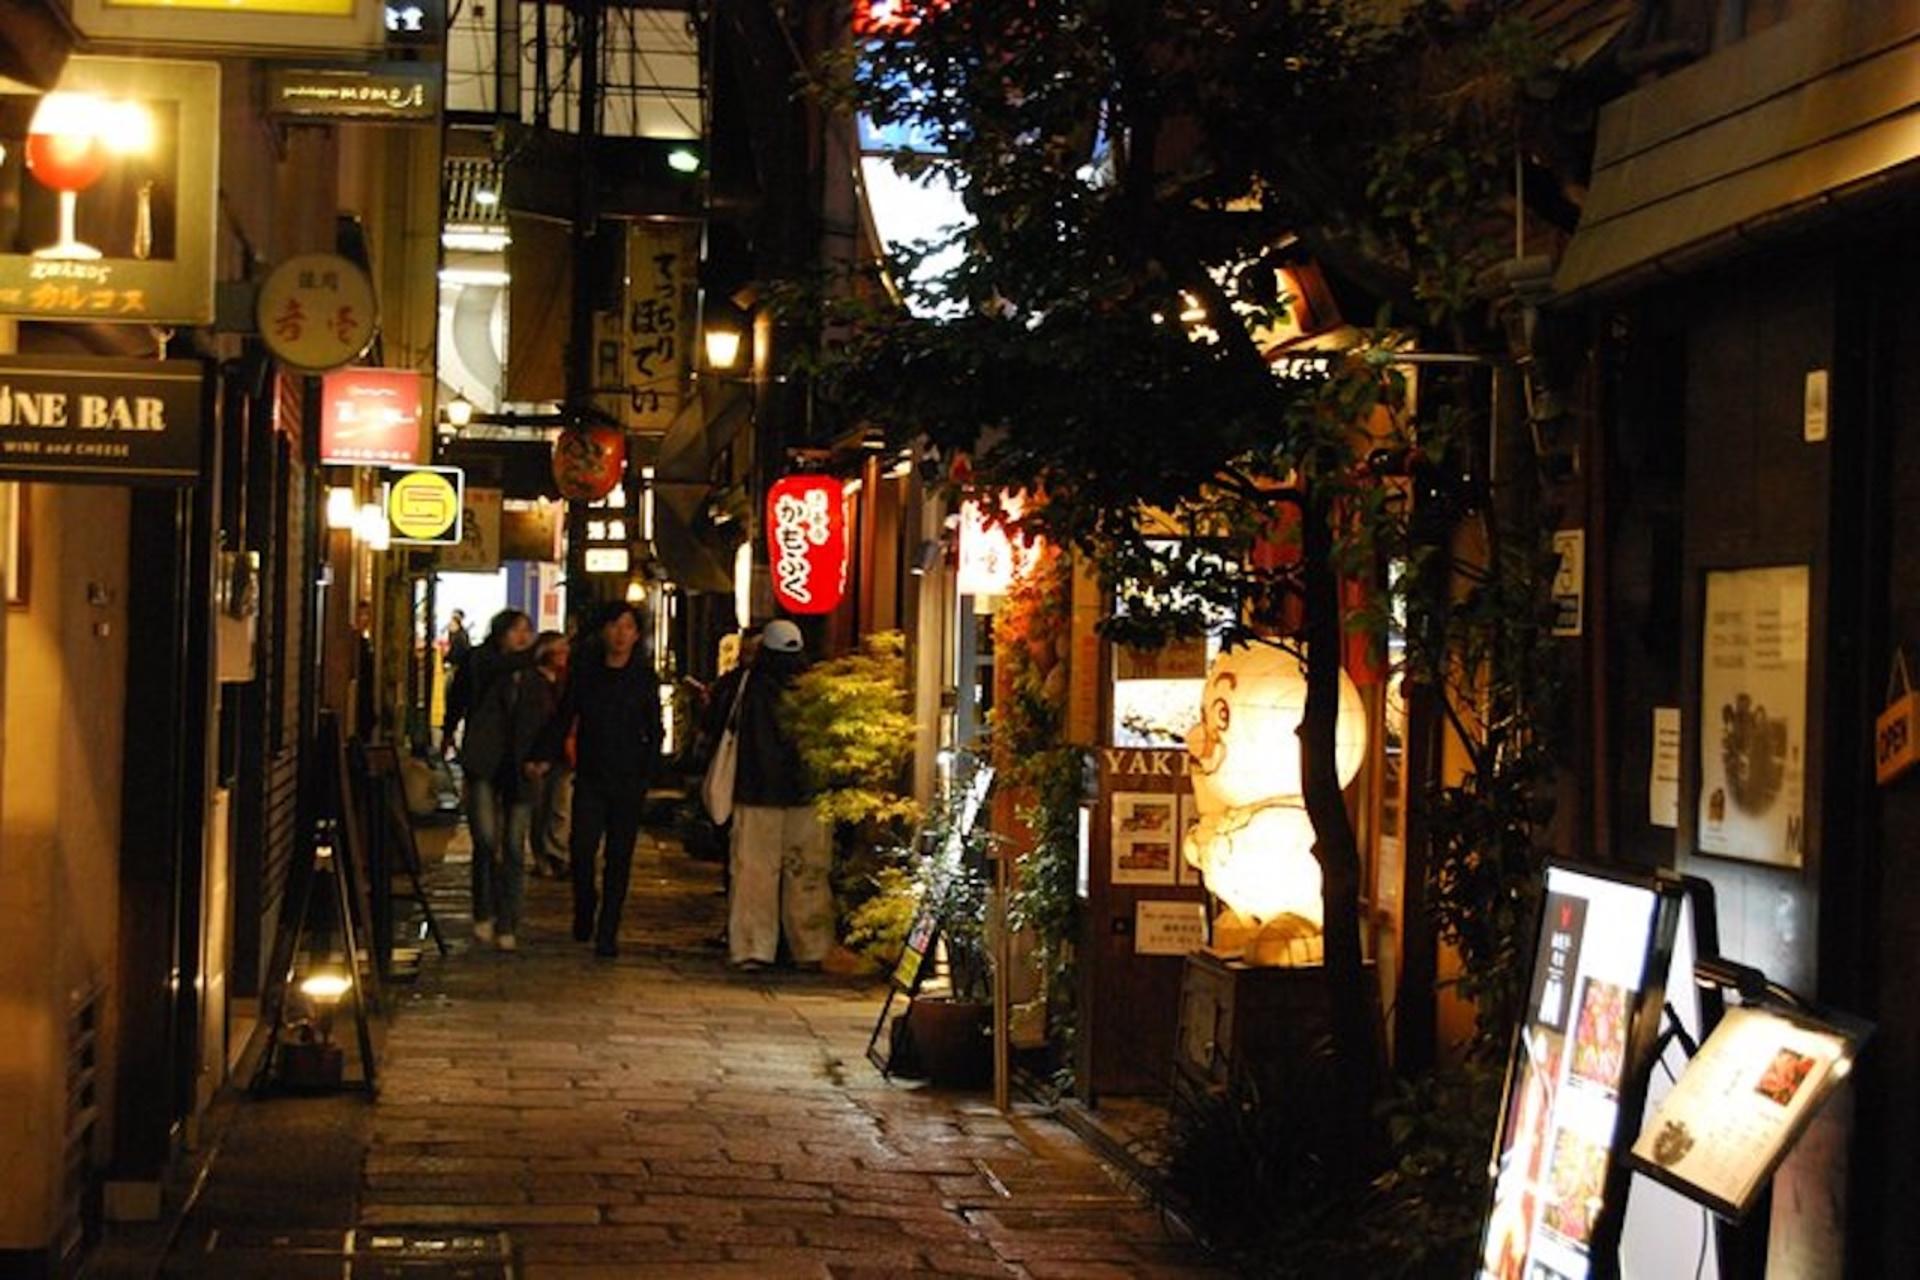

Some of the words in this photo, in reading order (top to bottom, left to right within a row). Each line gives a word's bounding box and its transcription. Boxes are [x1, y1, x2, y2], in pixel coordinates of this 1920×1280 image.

[30, 282, 144, 313] カルコス
[652, 251, 676, 363] てっちり
[631, 299, 659, 414] ほてい
[80, 395, 167, 431] BAR
[3, 441, 41, 453] WINE
[46, 443, 72, 455] and
[76, 444, 129, 457] CHEESE
